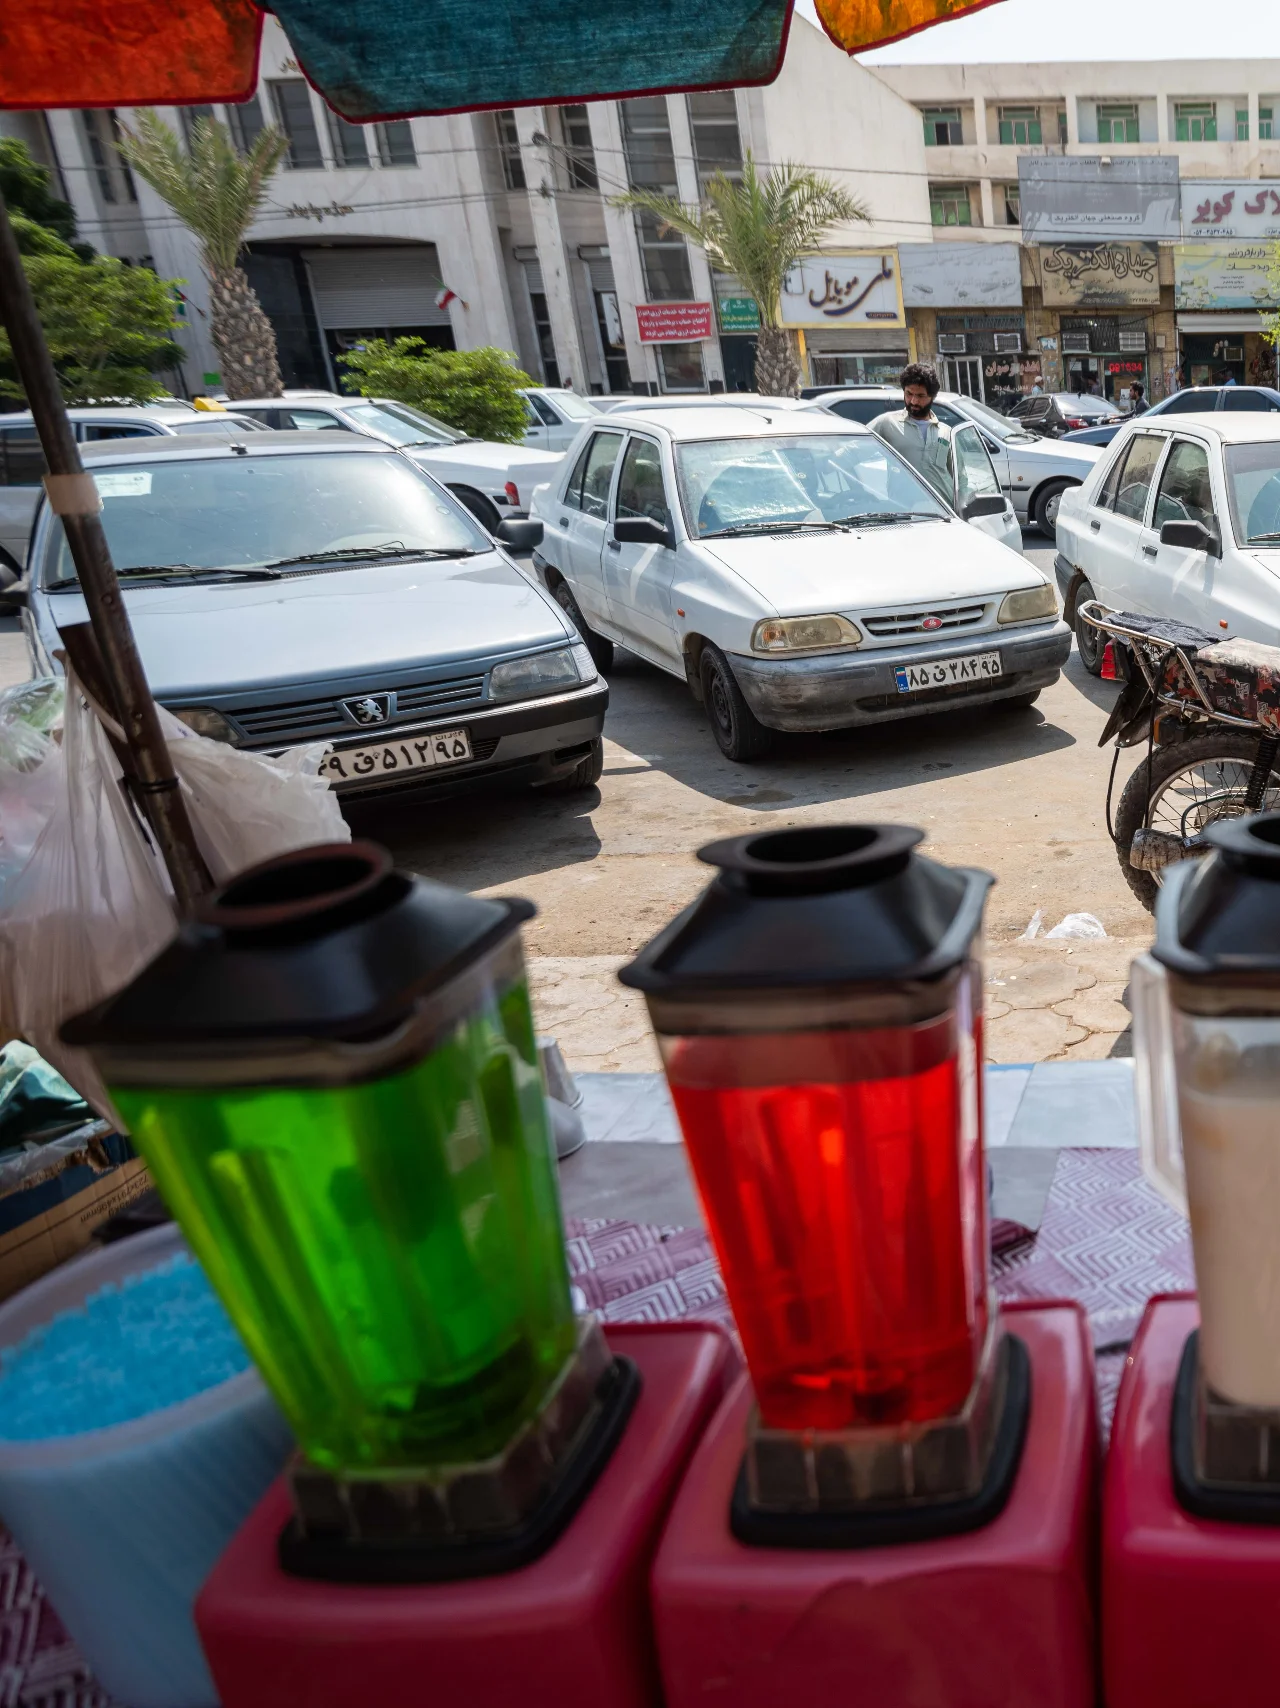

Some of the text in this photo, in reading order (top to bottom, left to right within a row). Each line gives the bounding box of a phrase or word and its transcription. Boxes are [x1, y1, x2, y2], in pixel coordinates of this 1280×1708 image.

[1190, 190, 1236, 224] کویر
[1043, 243, 1116, 279] الکتریک
[1114, 246, 1158, 283] جهان
[808, 255, 894, 317] ملی موبایل
[909, 658, 1000, 688] ۸۵ ق ۳۸۴ ۹۵
[353, 752, 375, 775] ق
[382, 740, 429, 770] ۵۱۲
[435, 738, 466, 759] ۹۵
